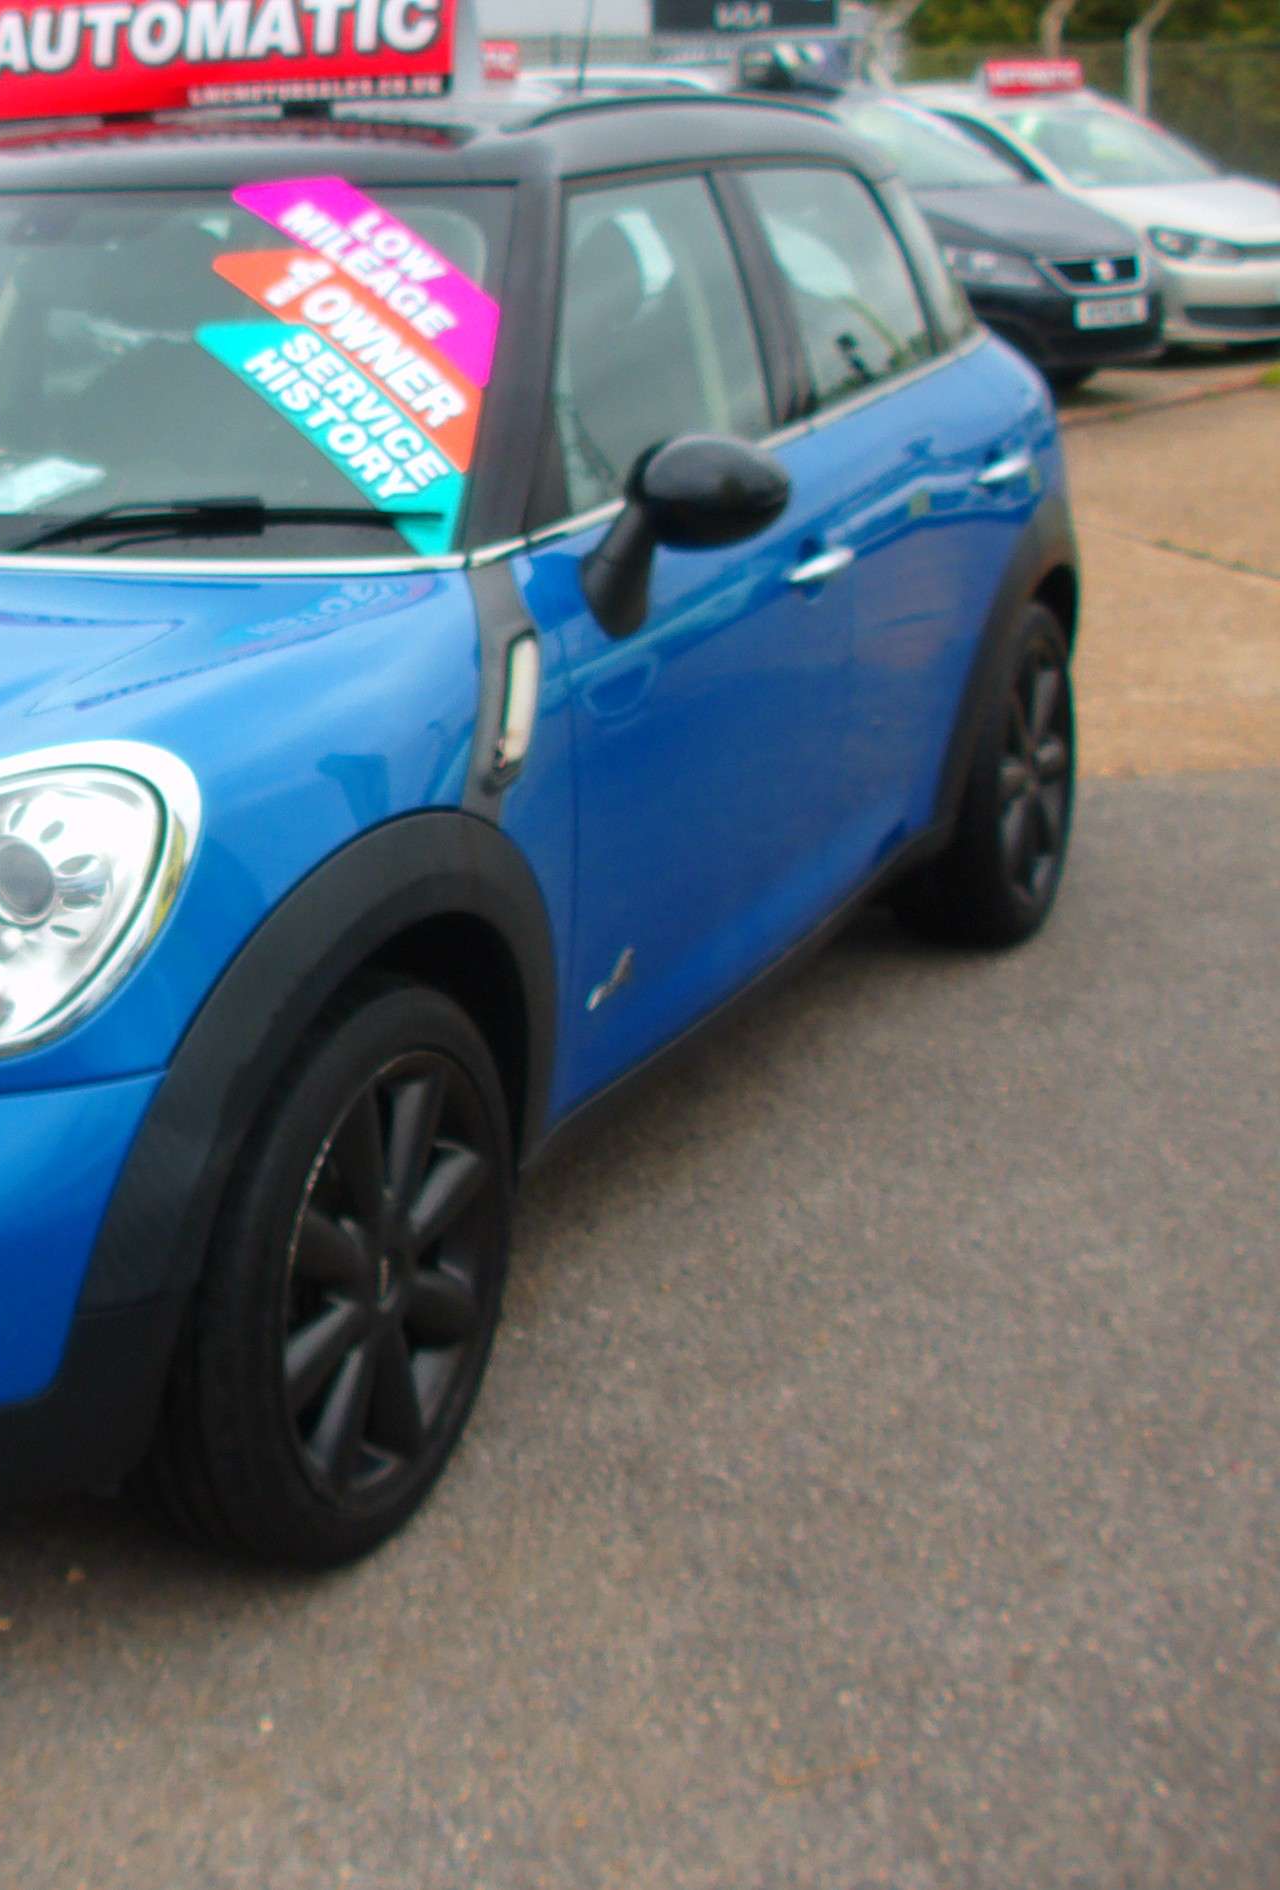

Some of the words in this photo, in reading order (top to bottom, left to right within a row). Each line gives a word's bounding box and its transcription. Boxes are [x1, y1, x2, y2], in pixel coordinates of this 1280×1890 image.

[278, 200, 457, 341] MILEAGE
[348, 209, 447, 284] LOW
[264, 256, 335, 307] 1
[301, 286, 467, 428] OWNER
[281, 331, 449, 486] SERVICE
[242, 348, 419, 499] HISTORY
